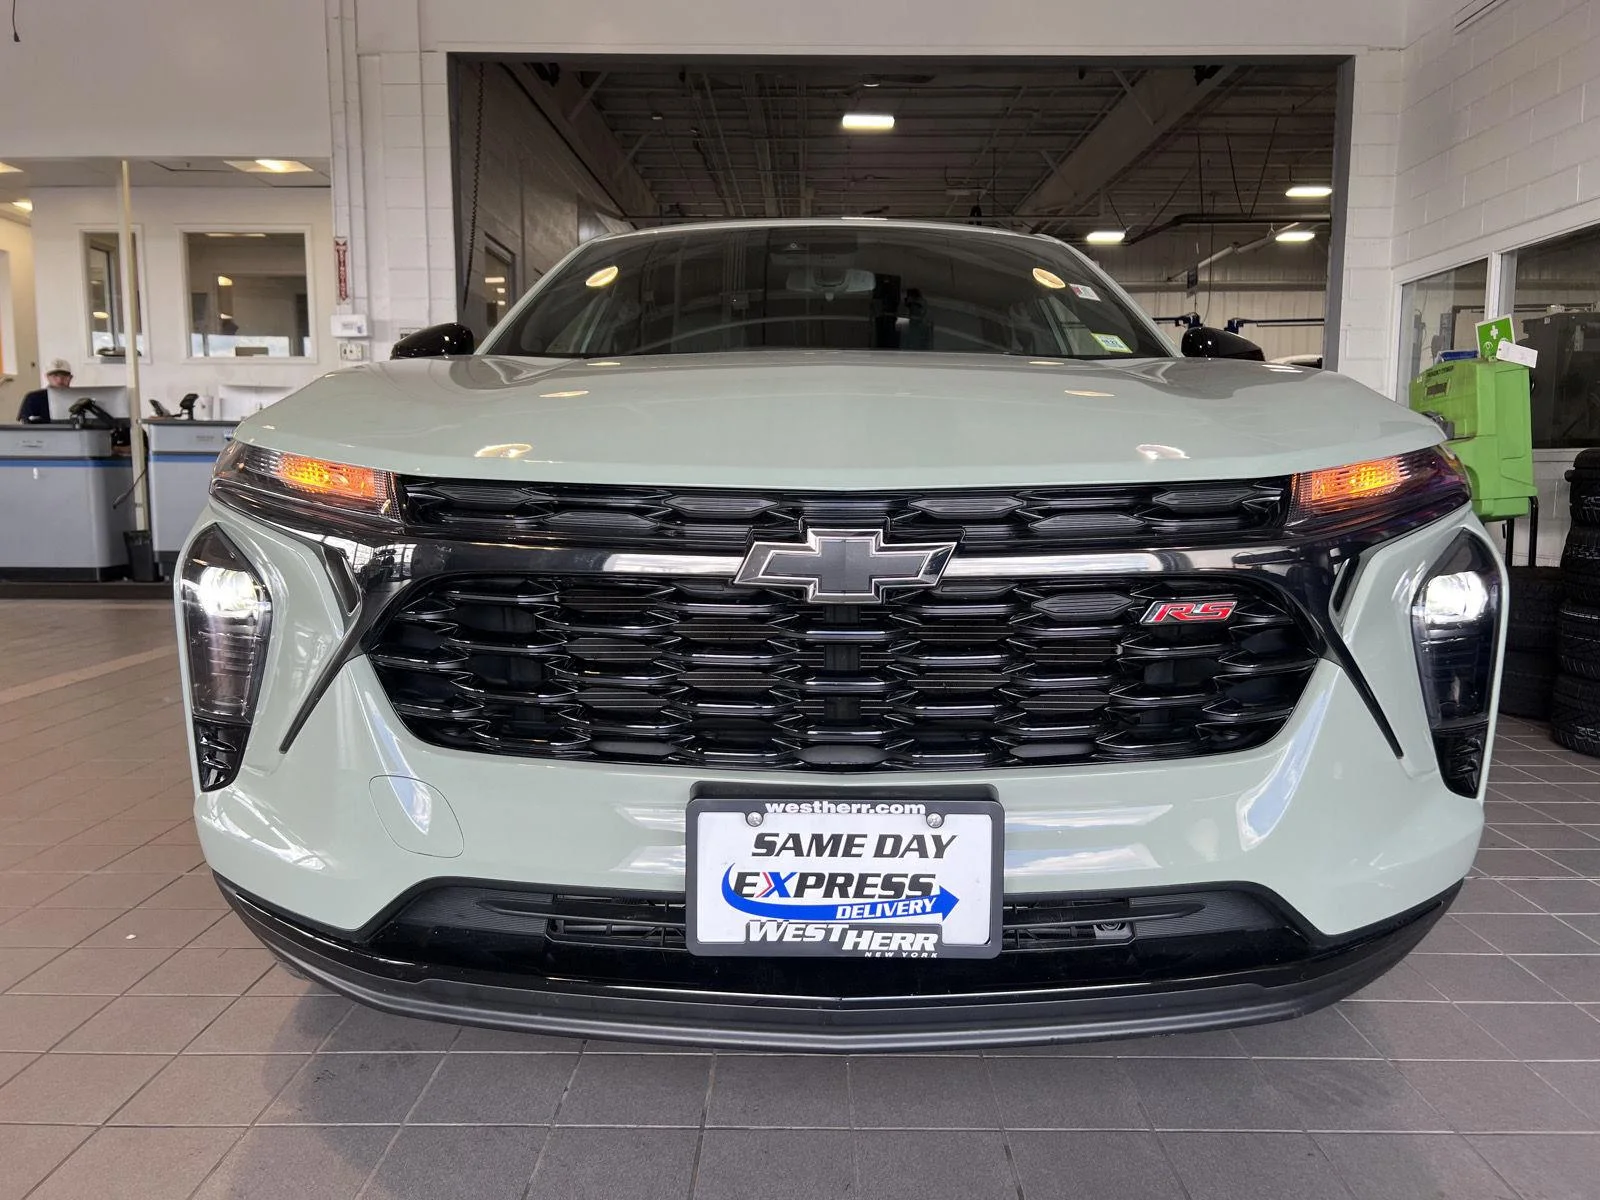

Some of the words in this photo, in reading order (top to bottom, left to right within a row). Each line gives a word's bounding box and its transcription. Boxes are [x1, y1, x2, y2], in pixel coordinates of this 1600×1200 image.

[1151, 601, 1237, 622] RS
[765, 801, 926, 815] westherr.com
[751, 832, 868, 858] SAME
[873, 833, 959, 859] DAY
[732, 871, 937, 899] EXPRESS
[836, 897, 937, 920] DELIVERY
[749, 919, 850, 942] WEST
[841, 929, 939, 951] HERR
